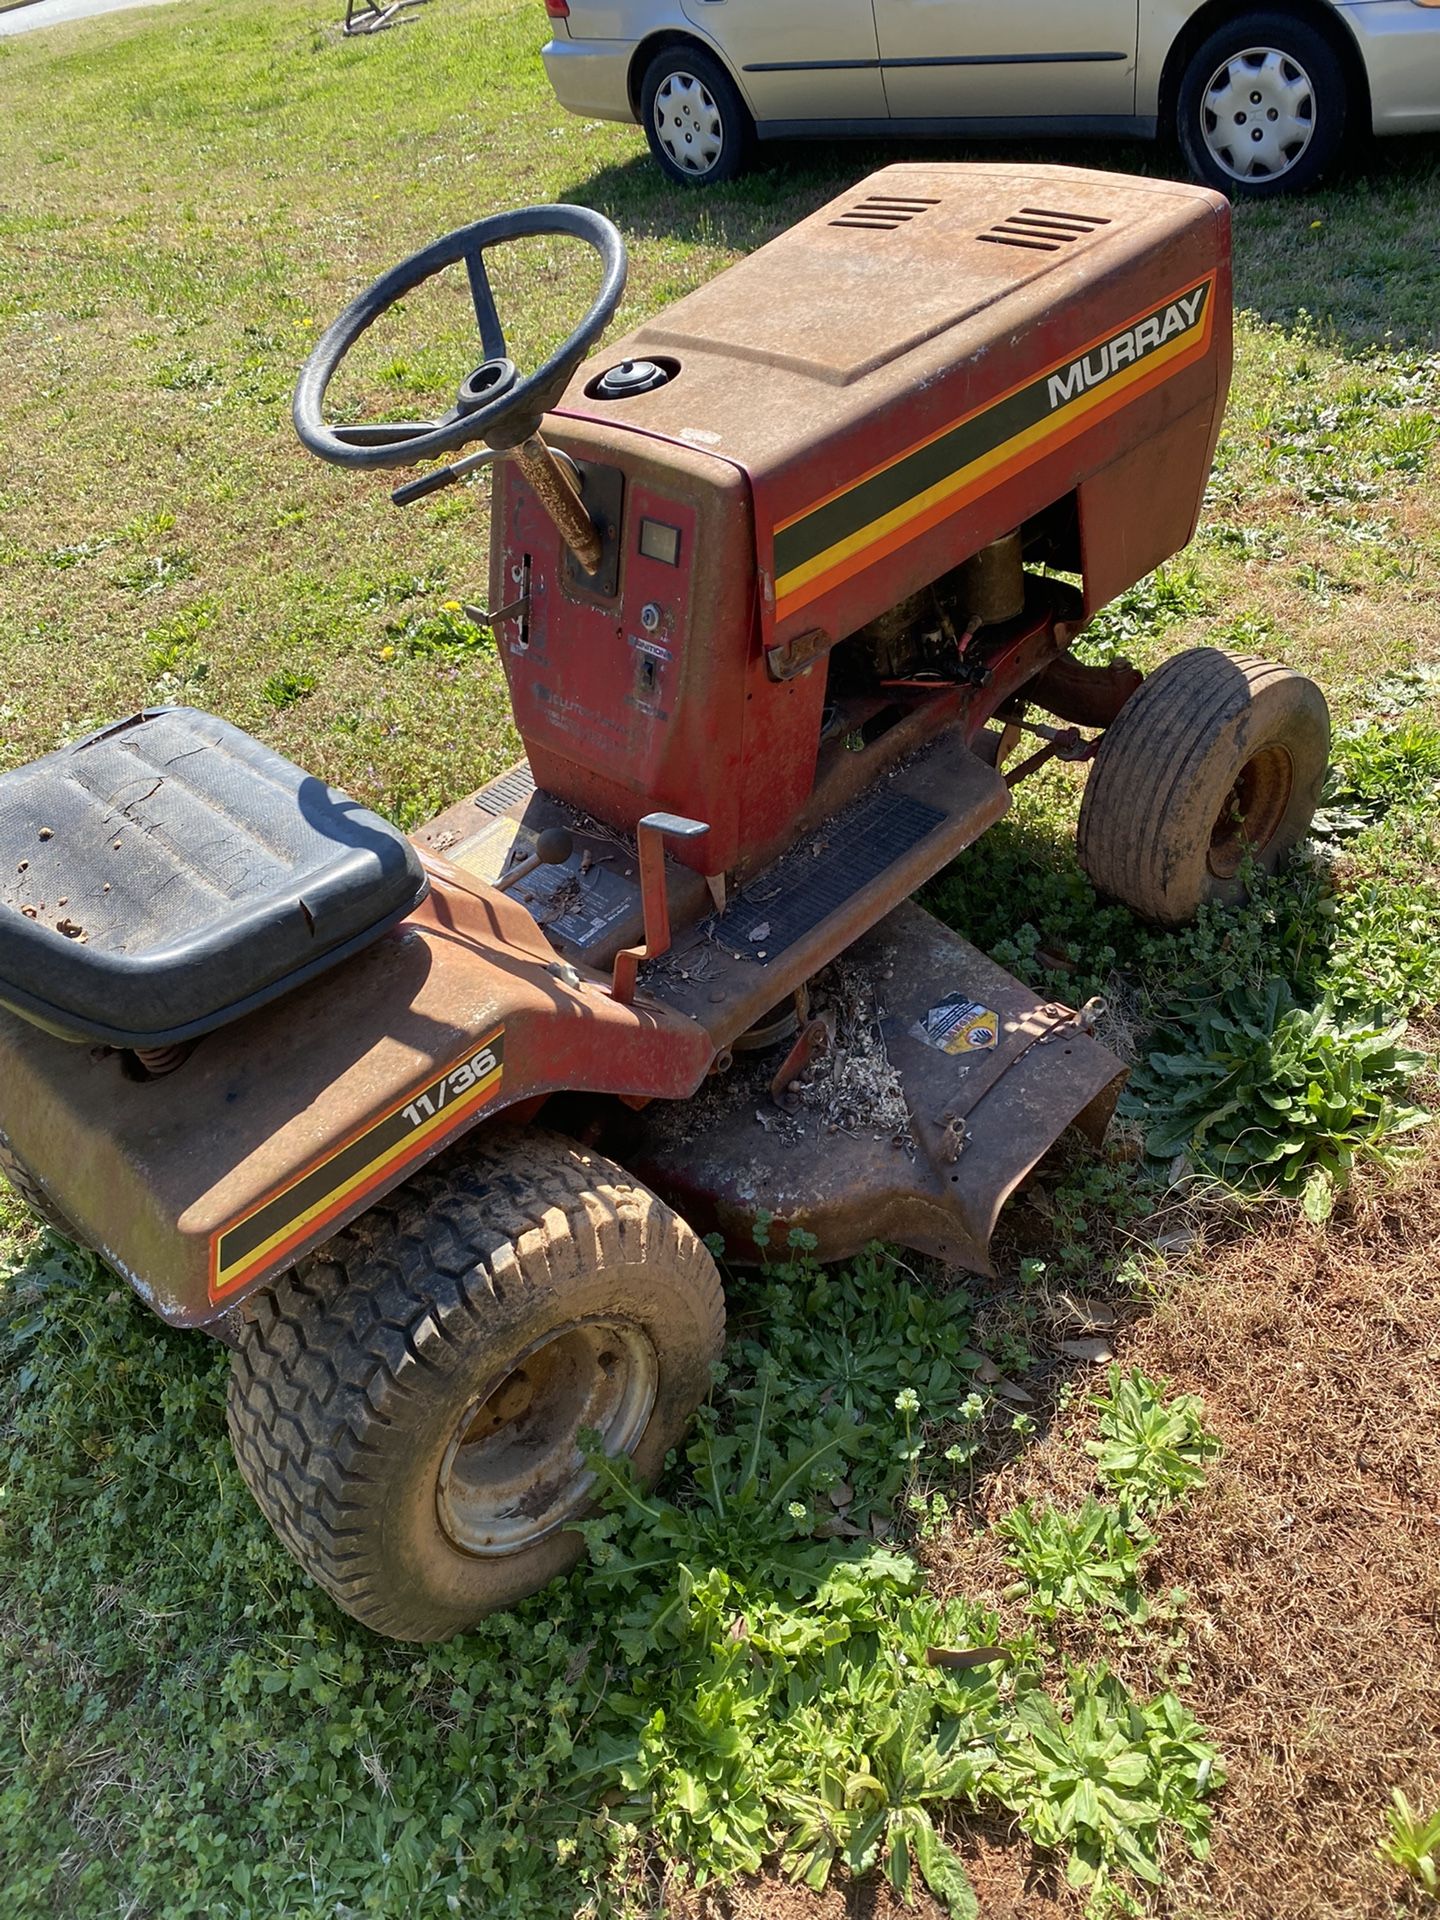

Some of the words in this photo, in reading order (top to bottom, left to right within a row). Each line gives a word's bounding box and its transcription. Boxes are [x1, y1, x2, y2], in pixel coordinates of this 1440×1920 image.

[1047, 288, 1203, 408] MURRAY
[941, 1011, 980, 1042] DANGER
[402, 1048, 497, 1126] 11/36
